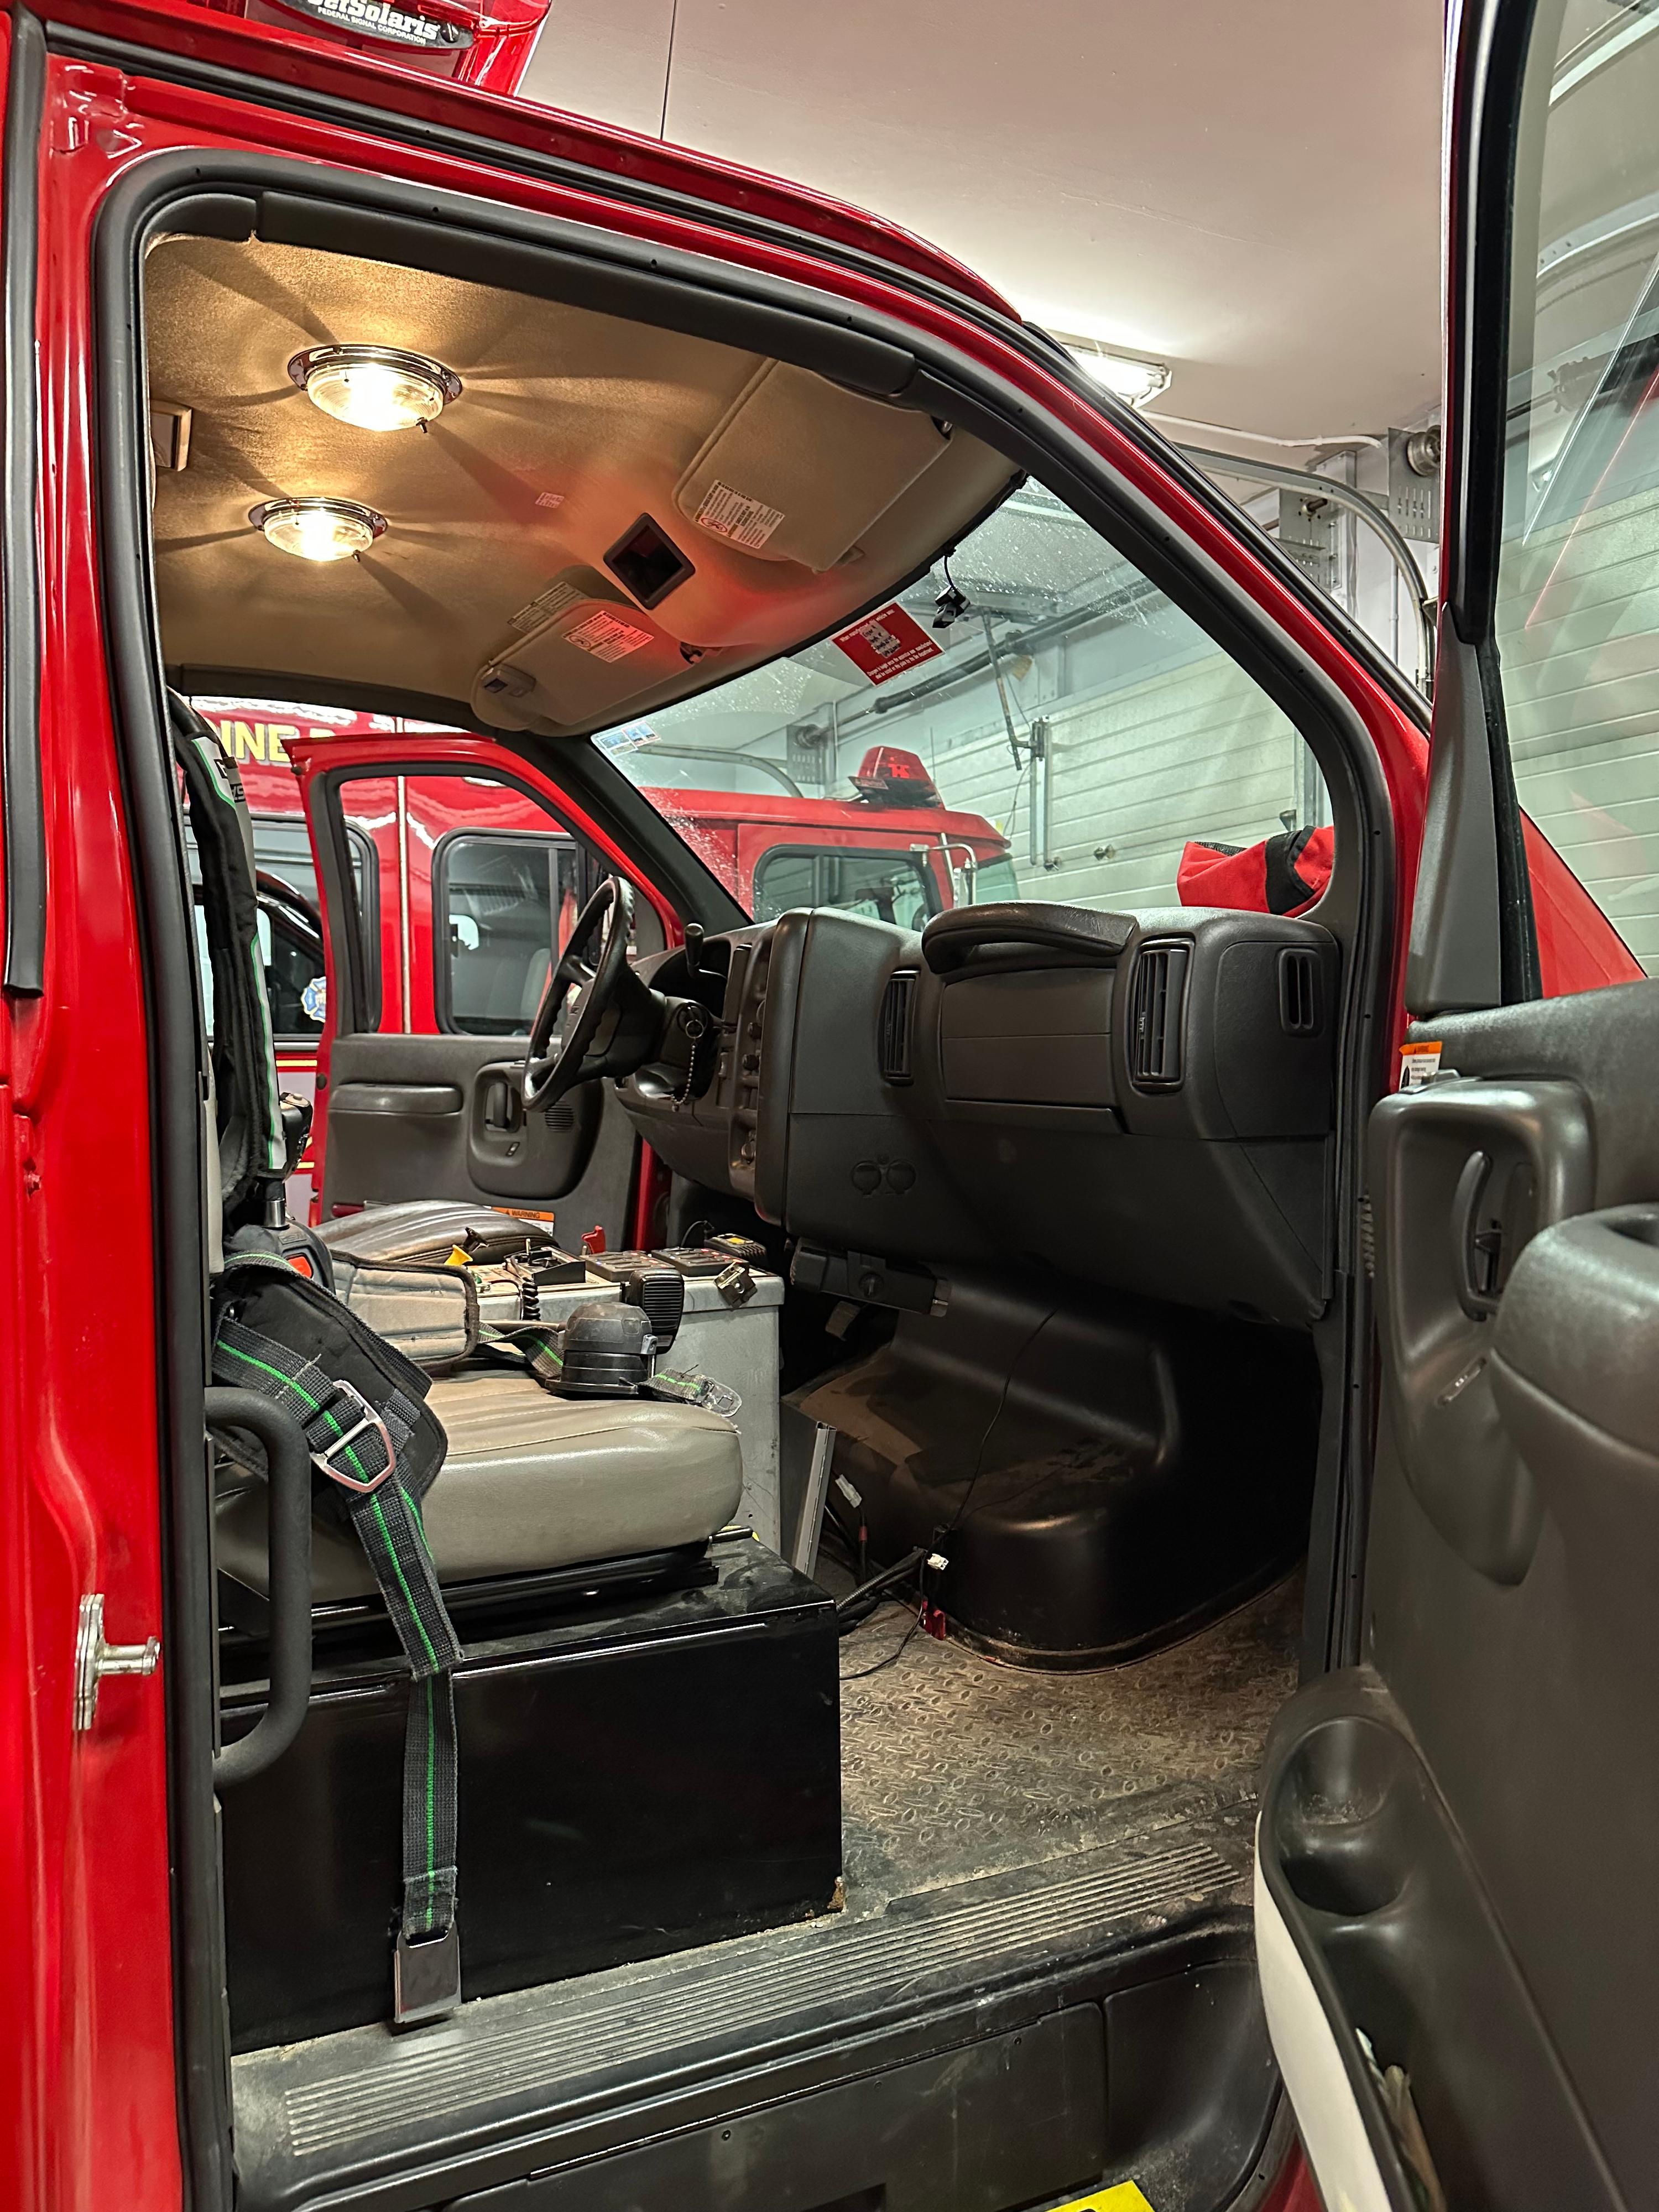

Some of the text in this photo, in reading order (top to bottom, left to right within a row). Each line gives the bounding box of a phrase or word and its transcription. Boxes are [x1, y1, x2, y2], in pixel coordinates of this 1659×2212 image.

[317, 6, 426, 45] FEDERAL SIGNAL CORPORATION
[205, 719, 296, 762] INE
[512, 1210, 540, 1219] WARNING
